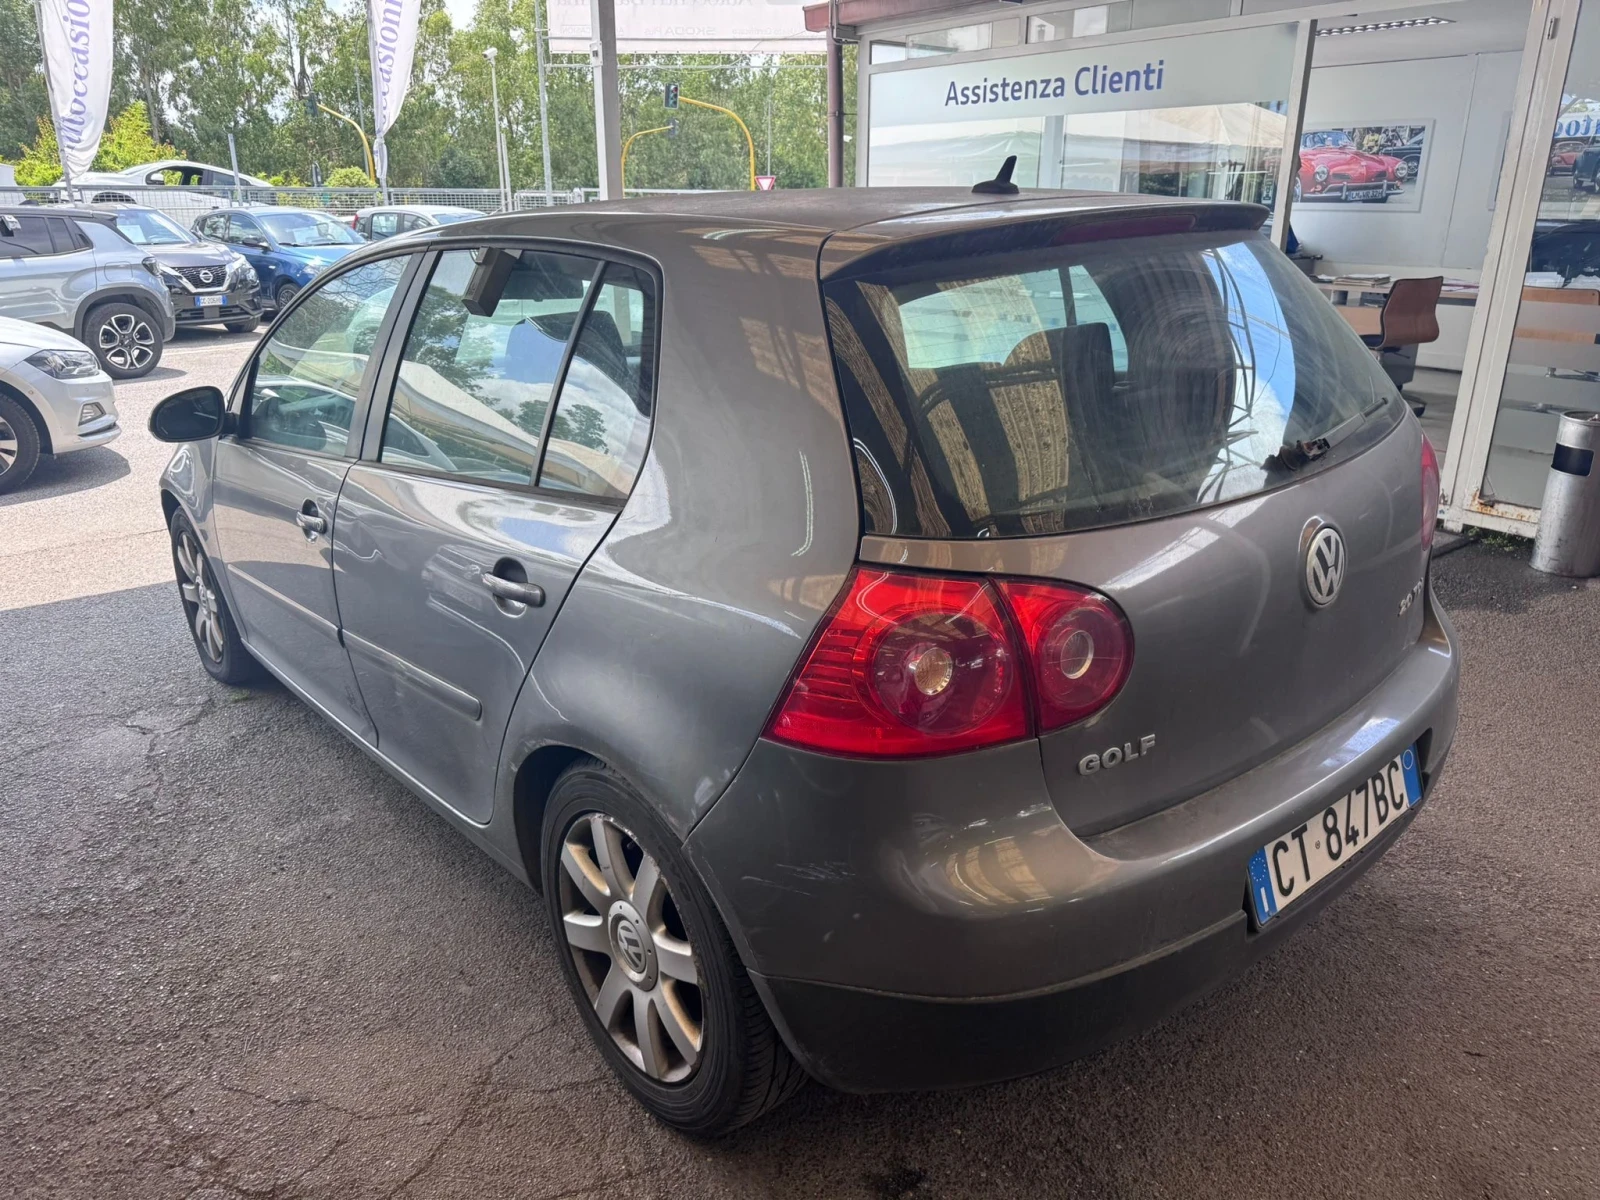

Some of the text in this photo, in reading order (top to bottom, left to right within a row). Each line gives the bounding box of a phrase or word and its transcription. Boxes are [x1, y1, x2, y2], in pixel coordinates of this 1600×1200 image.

[945, 60, 1164, 106] Assistenza Clienti
[1078, 733, 1156, 776] GOLF
